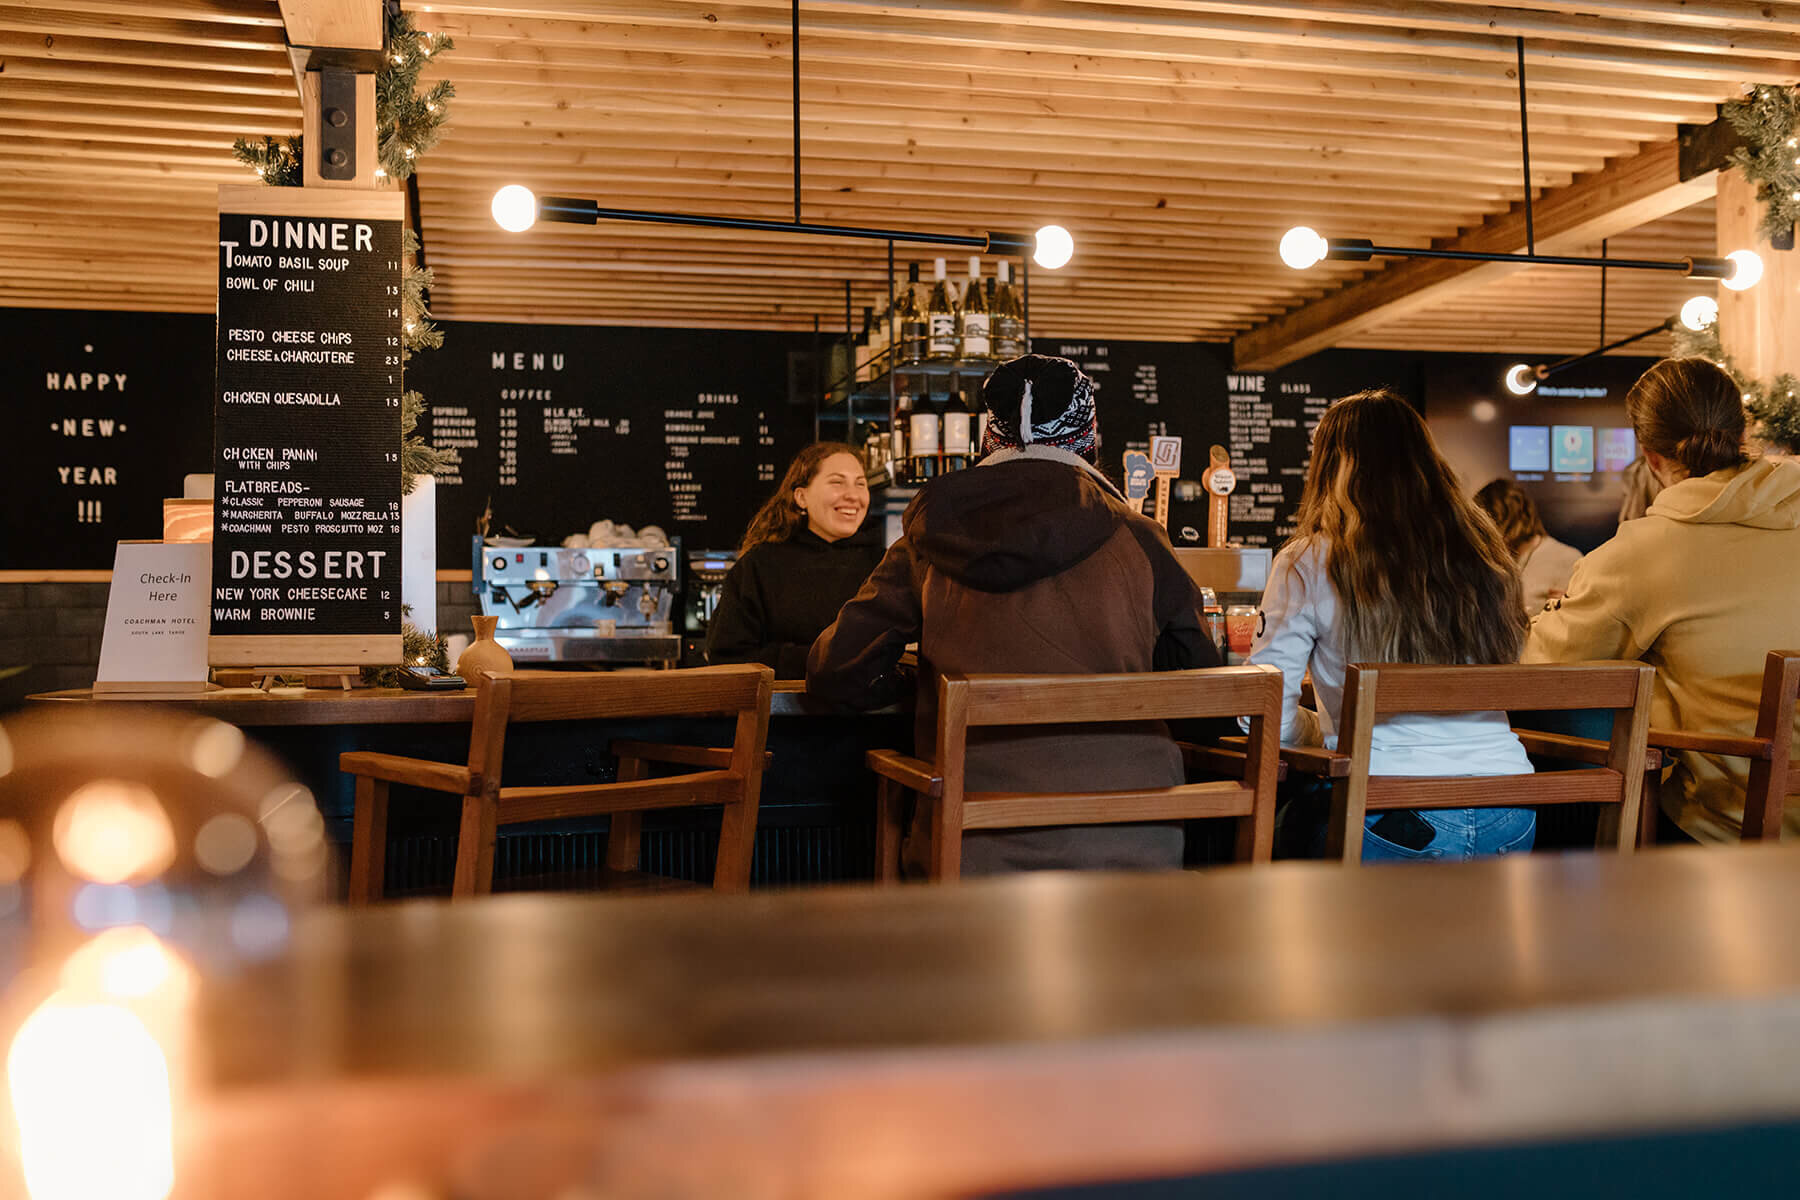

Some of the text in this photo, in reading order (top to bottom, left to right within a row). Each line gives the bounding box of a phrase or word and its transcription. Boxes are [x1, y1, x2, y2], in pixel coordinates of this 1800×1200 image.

[250, 219, 372, 252] DINNER
[220, 241, 398, 272] TOMATO BASIL SOUP 11
[226, 277, 260, 290] BOWL
[263, 278, 279, 291] OF
[284, 279, 314, 292] CHILI
[387, 309, 398, 318] 14
[228, 329, 398, 346] PESTO CHEESE CHIPS 12
[385, 356, 399, 365] 23
[491, 352, 564, 371] MENU
[46, 372, 127, 391] HAPPY
[388, 375, 393, 384] 1
[1226, 375, 1266, 392] WINE
[223, 391, 270, 404] CHICKEN
[274, 392, 341, 405] QUESADILLA
[501, 389, 551, 401] COFFEE
[698, 393, 739, 404] DRINKS
[282, 448, 318, 461] PANINI
[238, 461, 291, 470] WITH CHIPS
[58, 466, 117, 485] YEAR
[277, 497, 323, 507] PEPPERONI
[329, 498, 364, 507] SAUSAGE
[294, 511, 334, 520] BUFFALO
[281, 524, 310, 533] PESTO
[367, 525, 384, 534] MOZ
[231, 551, 386, 579] DESSERT
[140, 573, 191, 584] Check-In
[149, 591, 178, 602] Here
[216, 588, 390, 600] NEW YORK CHEESECAKE 12
[214, 608, 390, 621] WARM BROWNIE 5
